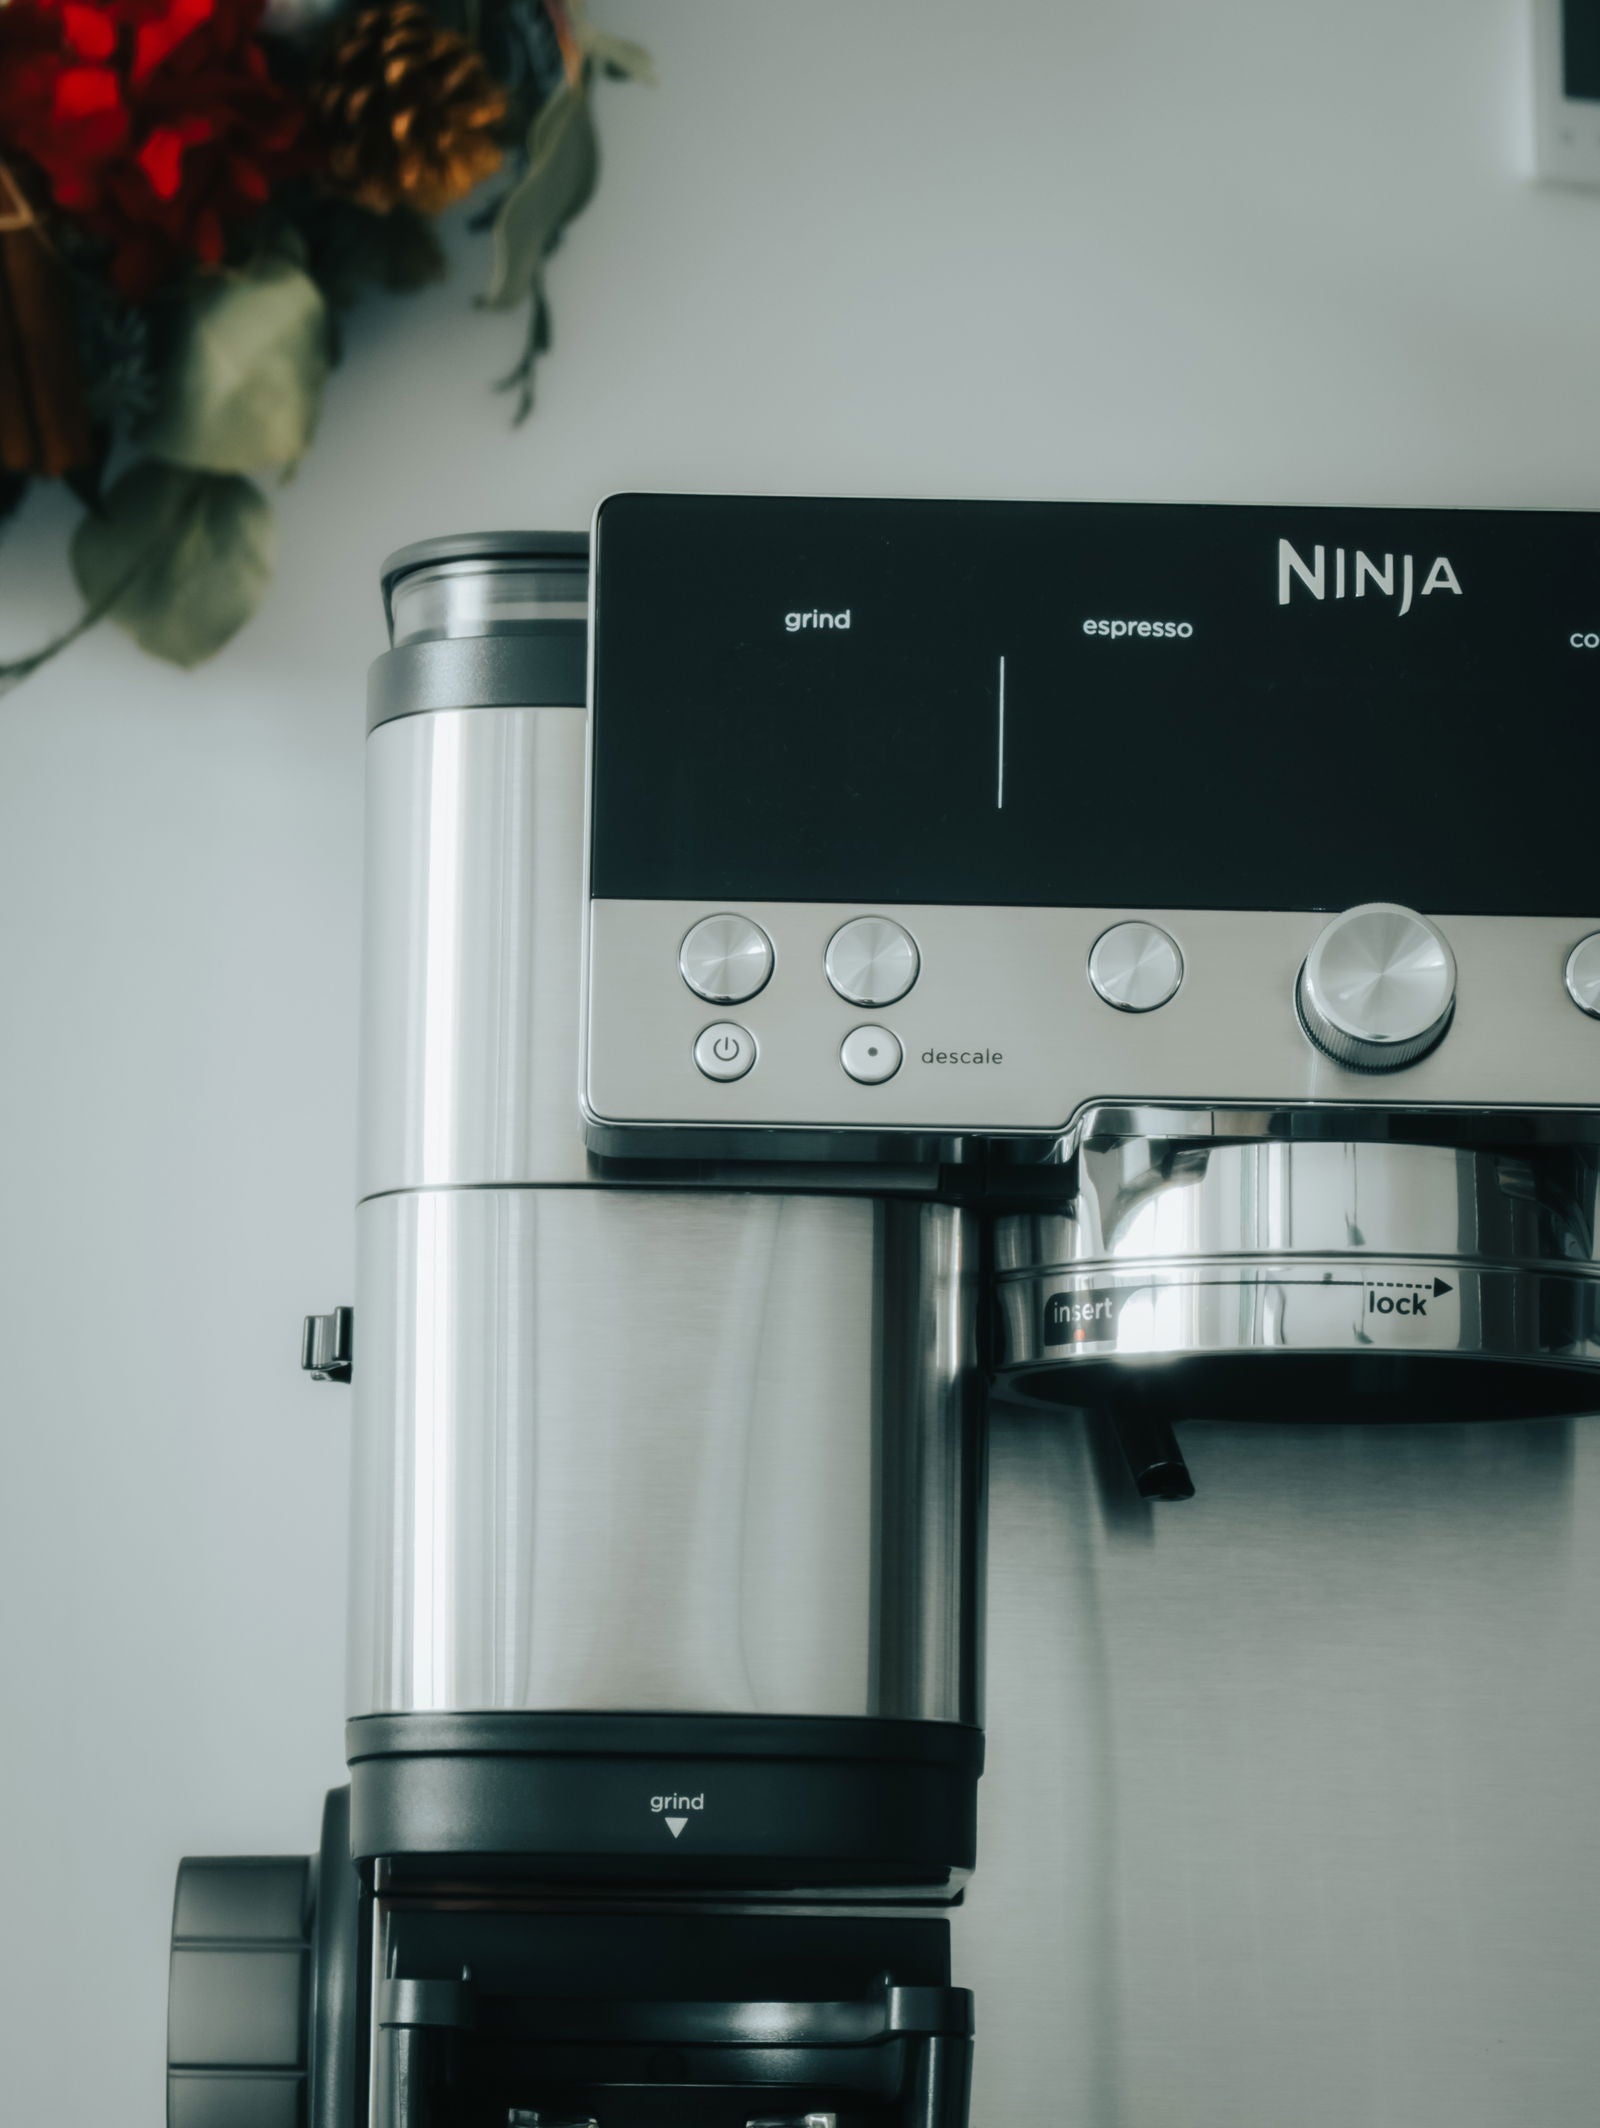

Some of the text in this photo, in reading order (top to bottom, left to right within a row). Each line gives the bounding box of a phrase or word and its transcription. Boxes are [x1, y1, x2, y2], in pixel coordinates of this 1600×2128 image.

[1278, 538, 1463, 617] NINJA
[784, 609, 851, 633] grind
[1082, 619, 1194, 640] espresso
[921, 1048, 1003, 1065] descale
[1053, 1297, 1113, 1324] insert
[1369, 1290, 1427, 1316] lock
[649, 1791, 705, 1814] grind
